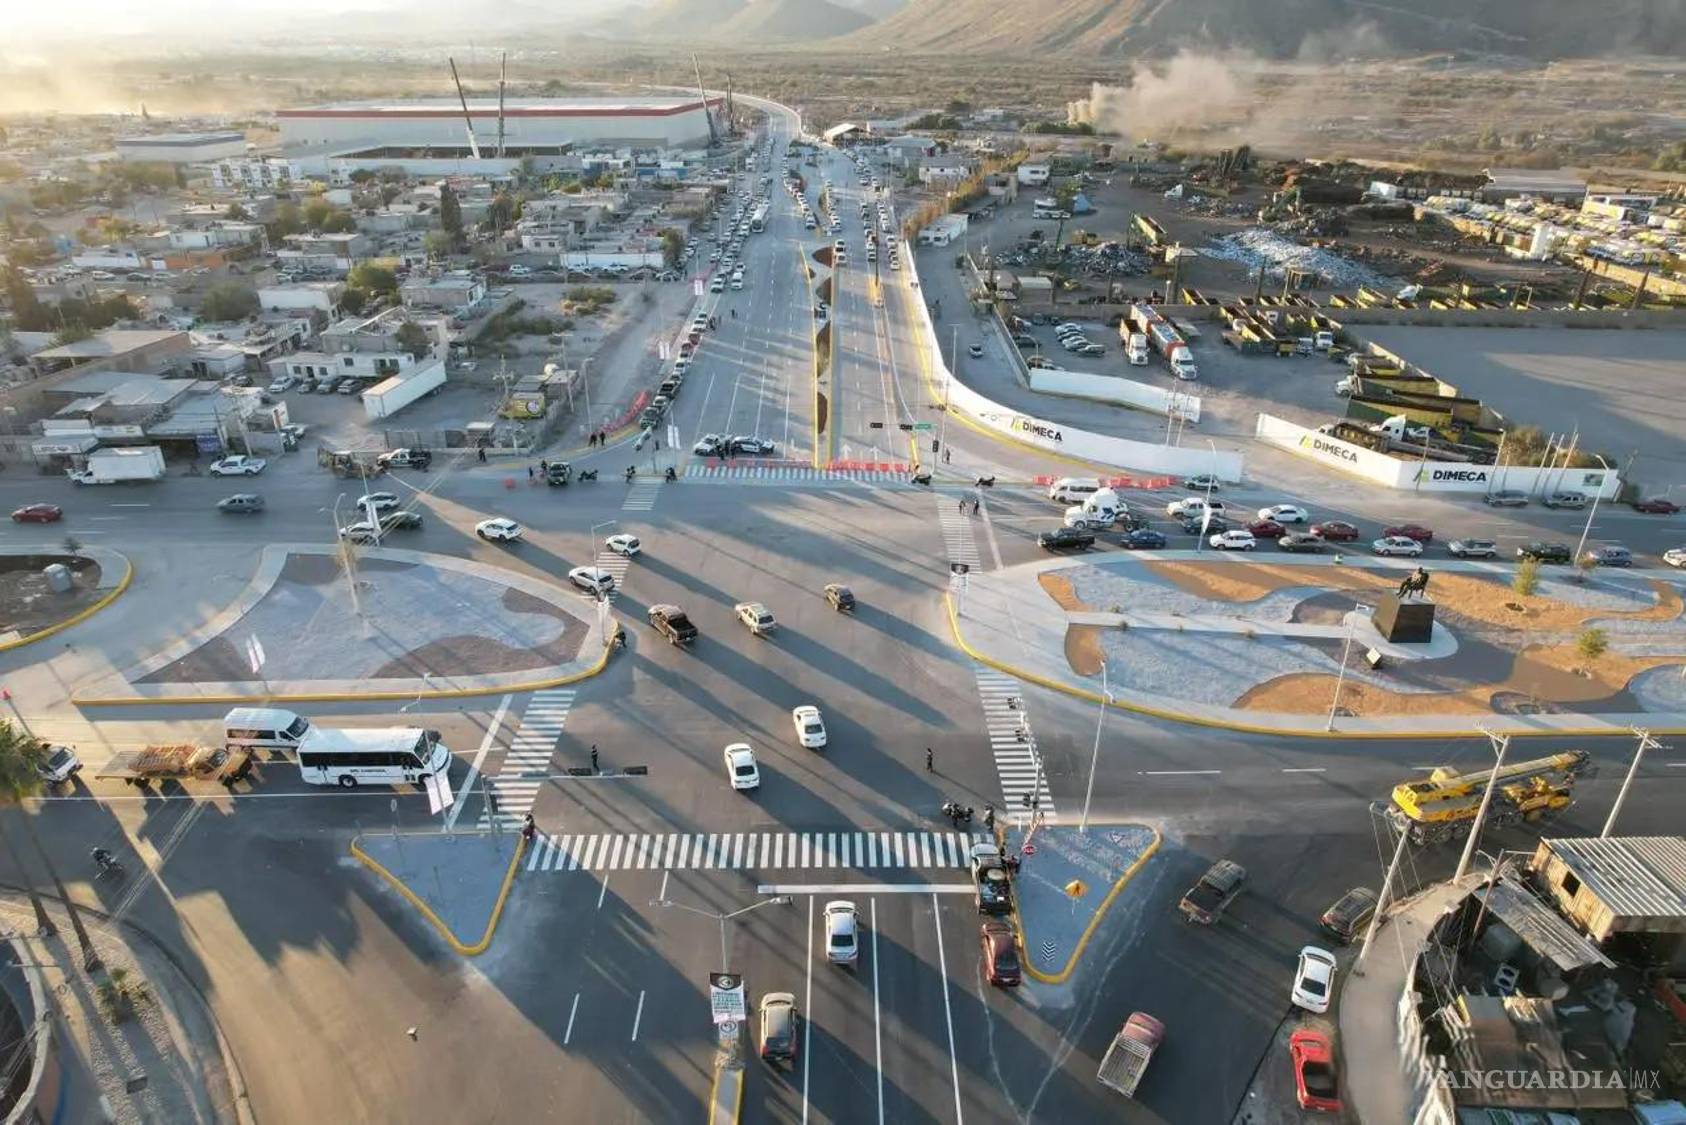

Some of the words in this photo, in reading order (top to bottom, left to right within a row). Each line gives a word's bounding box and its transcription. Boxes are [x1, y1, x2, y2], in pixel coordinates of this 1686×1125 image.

[1022, 421, 1063, 442] DIMECA
[1313, 439, 1358, 463] DIMECA
[1432, 469, 1487, 482] DIMECA
